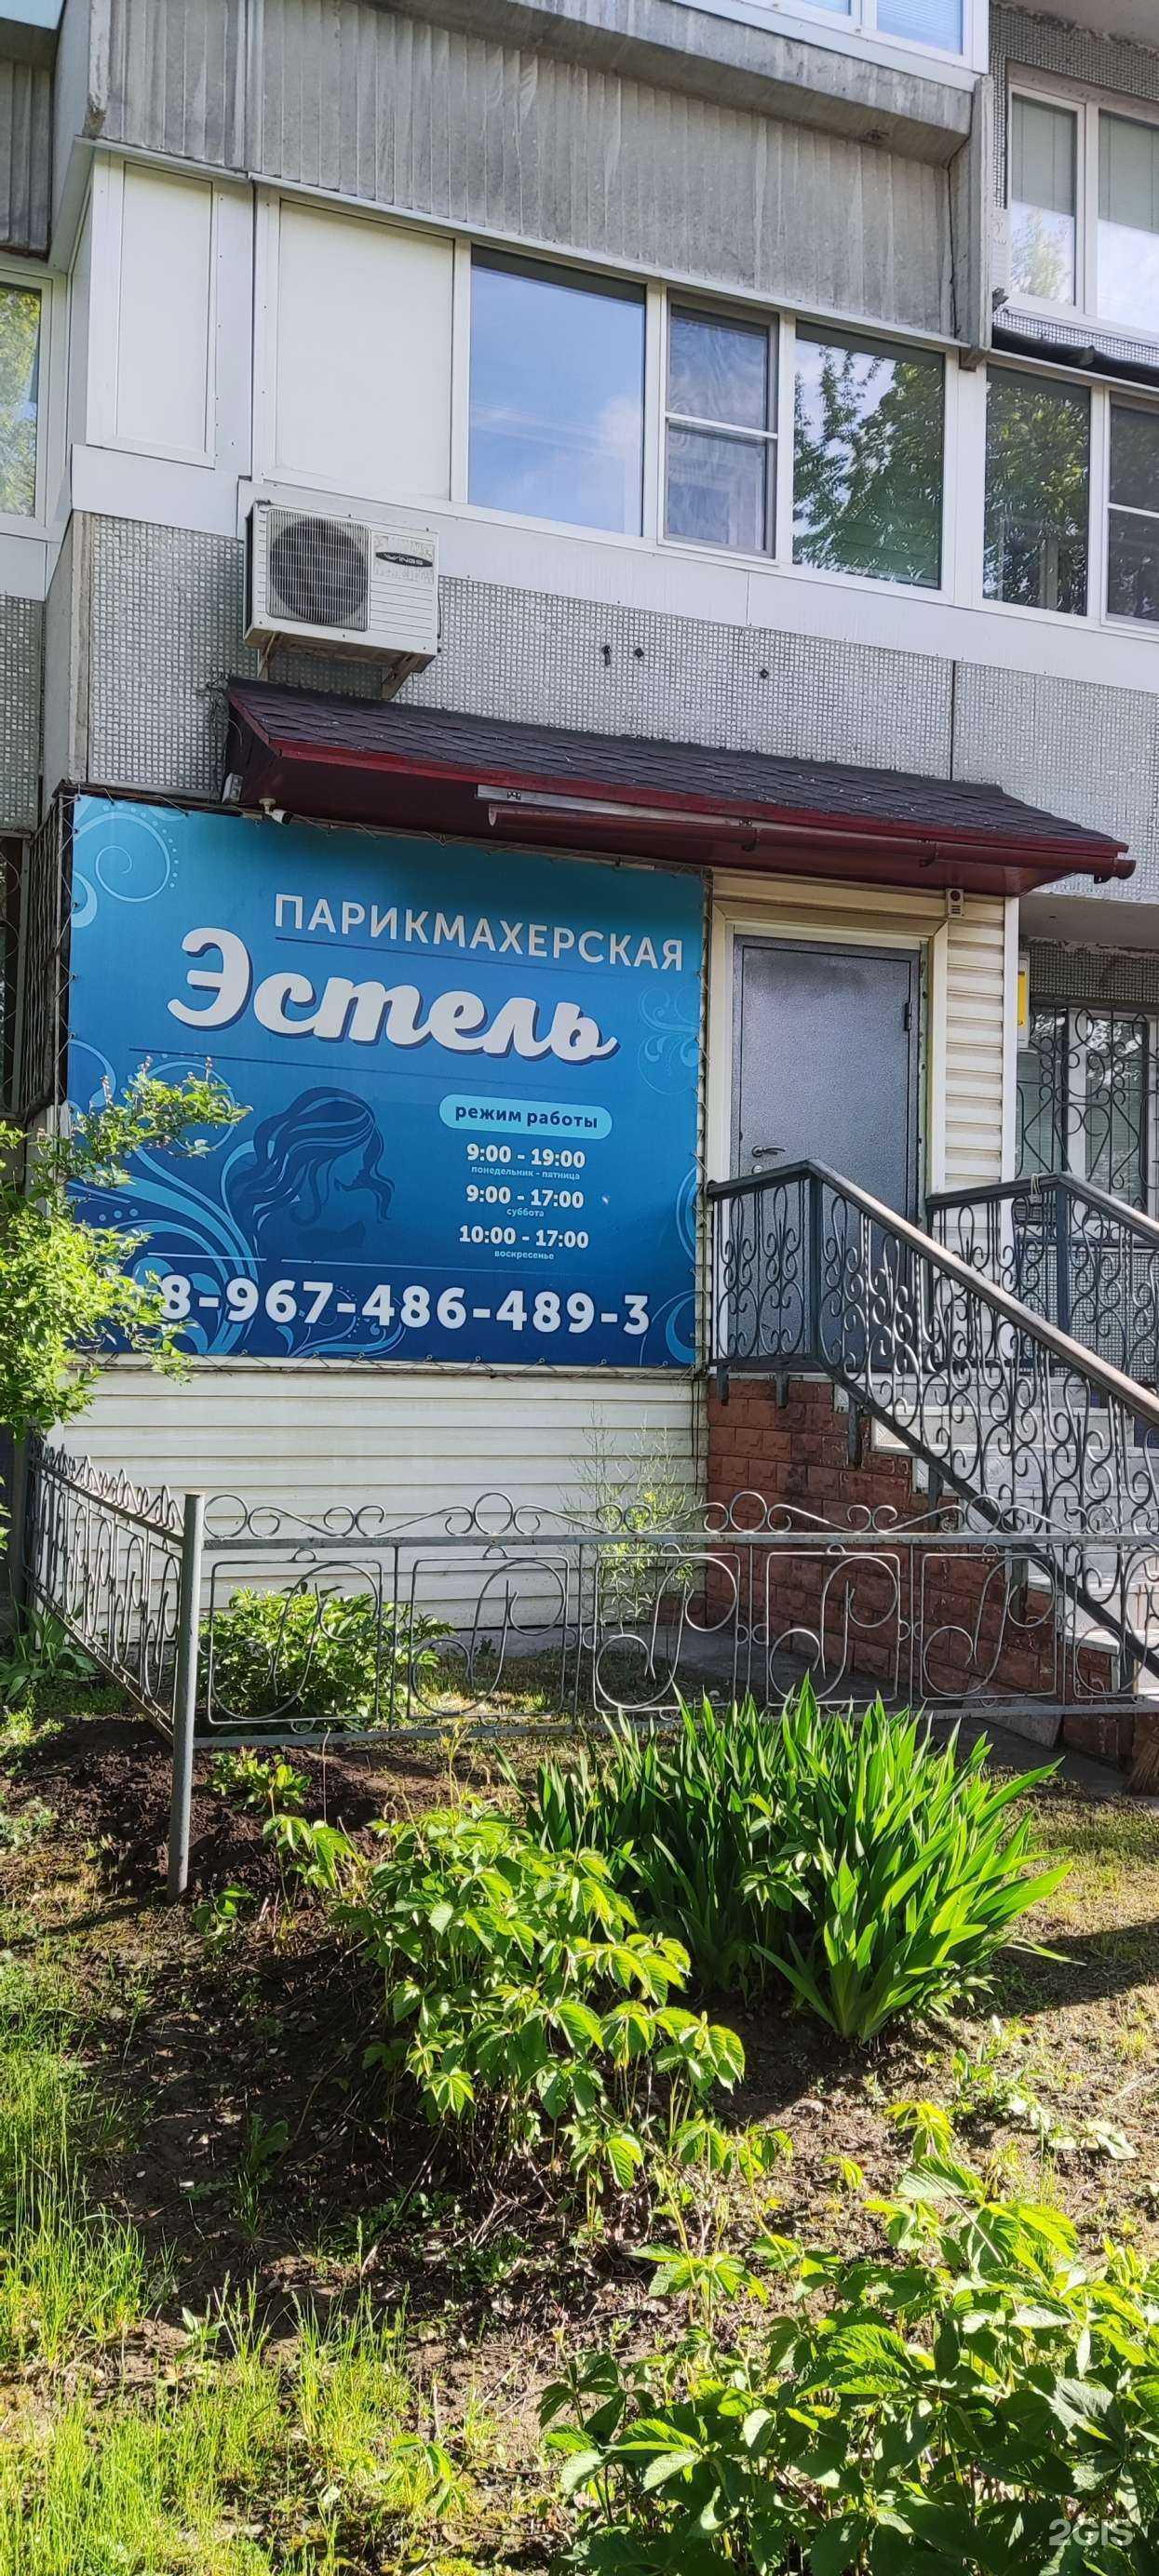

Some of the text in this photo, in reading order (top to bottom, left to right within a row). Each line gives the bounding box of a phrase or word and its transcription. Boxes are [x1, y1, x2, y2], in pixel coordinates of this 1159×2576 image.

[275, 893, 683, 971] ПАРИКМАХЕРСКАЯ
[168, 927, 618, 1063] Эстель
[455, 1106, 598, 1128] режим работы
[466, 1143, 511, 1163] 9:00
[531, 1147, 586, 1168] 19:00
[471, 1165, 533, 1177] понедельник
[542, 1170, 580, 1180] пятница
[466, 1184, 511, 1204] 9:00
[531, 1188, 585, 1208] 17:00
[506, 1207, 545, 1217] суббота
[459, 1225, 517, 1244] 10:00
[535, 1229, 588, 1248] 17:00
[494, 1250, 555, 1260] воскресенье
[160, 1274, 649, 1335] 8-967-486-489-3
